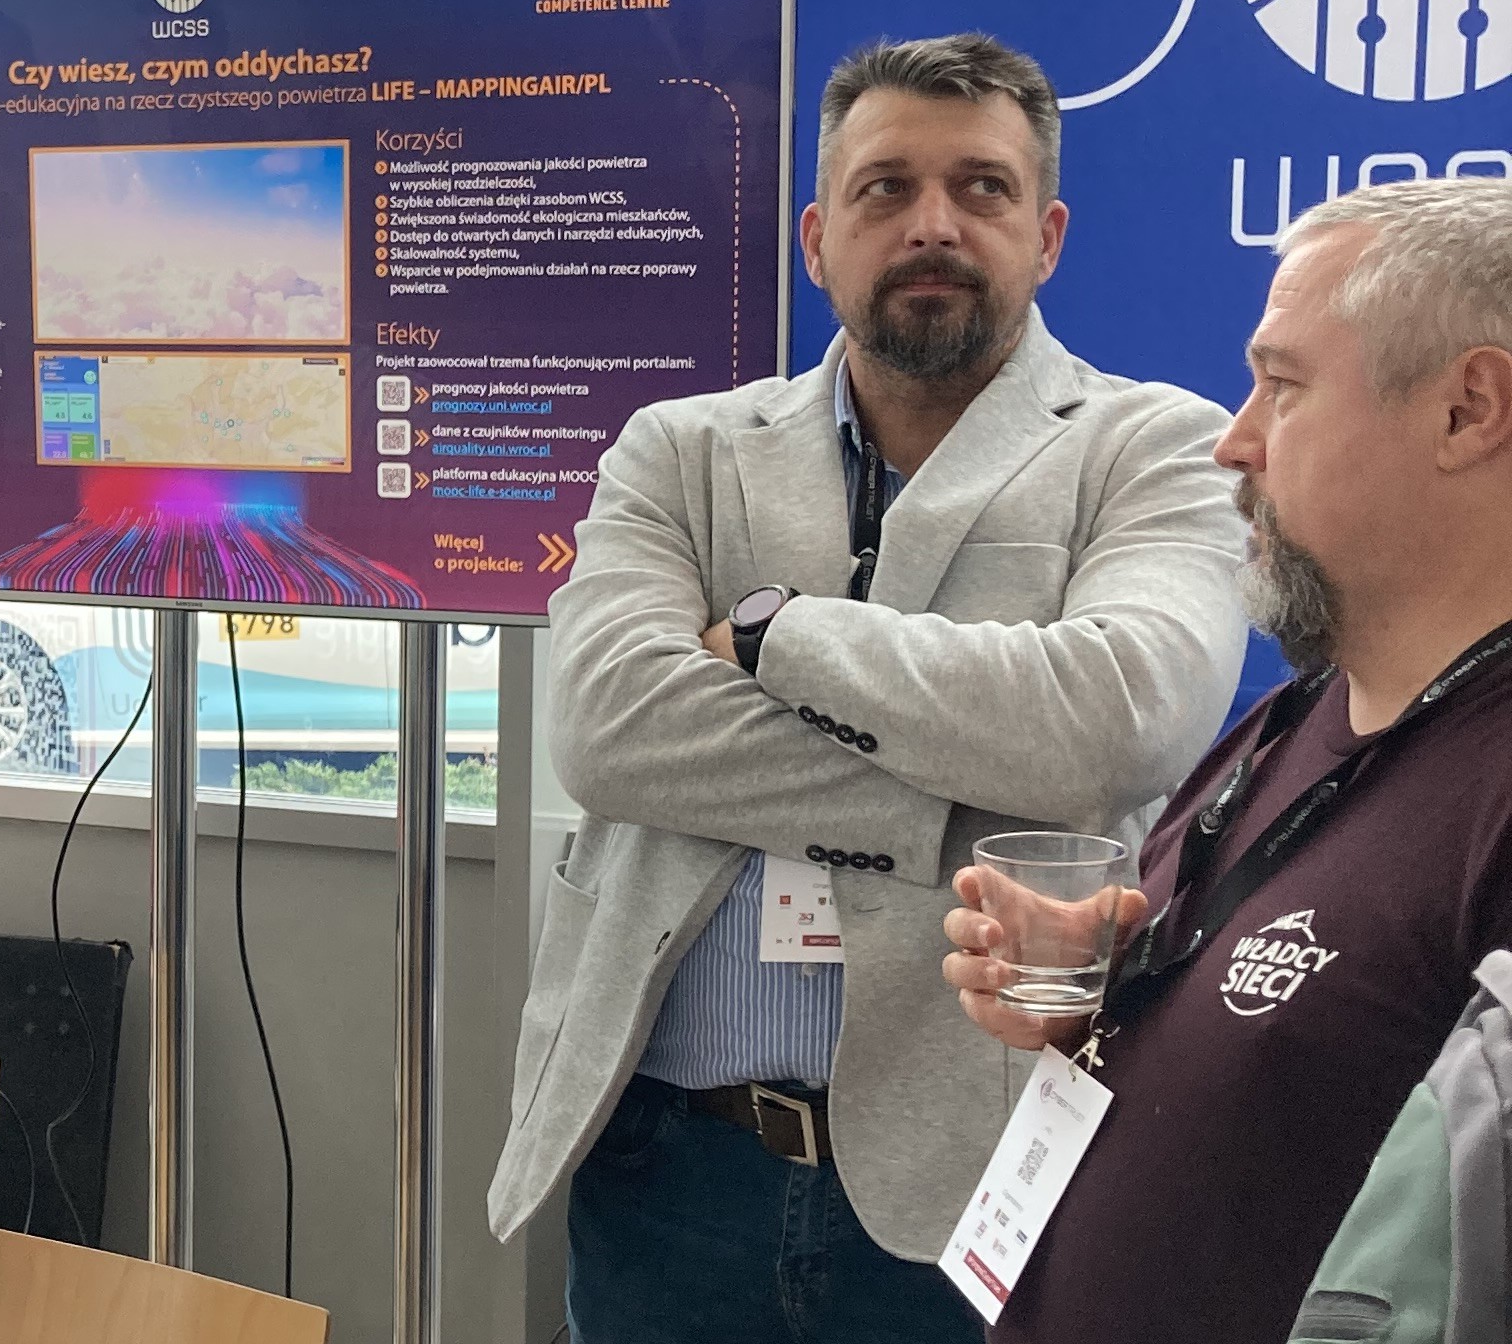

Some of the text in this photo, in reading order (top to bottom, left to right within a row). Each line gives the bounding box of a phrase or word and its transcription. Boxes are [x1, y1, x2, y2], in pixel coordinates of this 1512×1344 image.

[152, 19, 209, 38] WCSS
[8, 46, 373, 90] Czy wiesz, czym oddychasz?
[106, 96, 126, 111] na
[130, 93, 174, 110] rzecz
[178, 89, 272, 113] czystszego
[277, 85, 366, 106] powietrza
[372, 80, 415, 101] LIFE
[436, 73, 611, 99] MAPPINGAIR/PL
[376, 127, 463, 155] Korzyści
[390, 156, 648, 175] Możliwość prognozowania jakości powietrza
[390, 175, 537, 193] w wysokiej rozdzielczości,
[390, 191, 627, 210] Szybkie obliczenia dzięki zasobom WCSS,
[390, 208, 691, 228] Zwiększona świadomość ekologiczna mieszkańców,
[390, 225, 704, 245] Dostęp do otwartych danych narzędzi edukacyjnych,
[390, 246, 520, 261] Skalowalność systemu,
[390, 262, 697, 279] Wsparcie w podejmowaniu działań na rzecz poprawy
[390, 281, 449, 295] powietrza.
[376, 322, 441, 350] Efekty
[376, 354, 696, 371] Projekt zaowocował trzema funkcjonującymi portalami:
[432, 382, 589, 397] prognozy jakości powietrza
[432, 425, 607, 442] dane czujników monitoringu
[432, 468, 599, 485] platforma edukacyjna MOOC
[433, 533, 484, 552] Więcej
[434, 556, 524, 574] o projekcie:
[1231, 937, 1339, 973] WŁADCY
[1219, 960, 1307, 1002] SIECI
